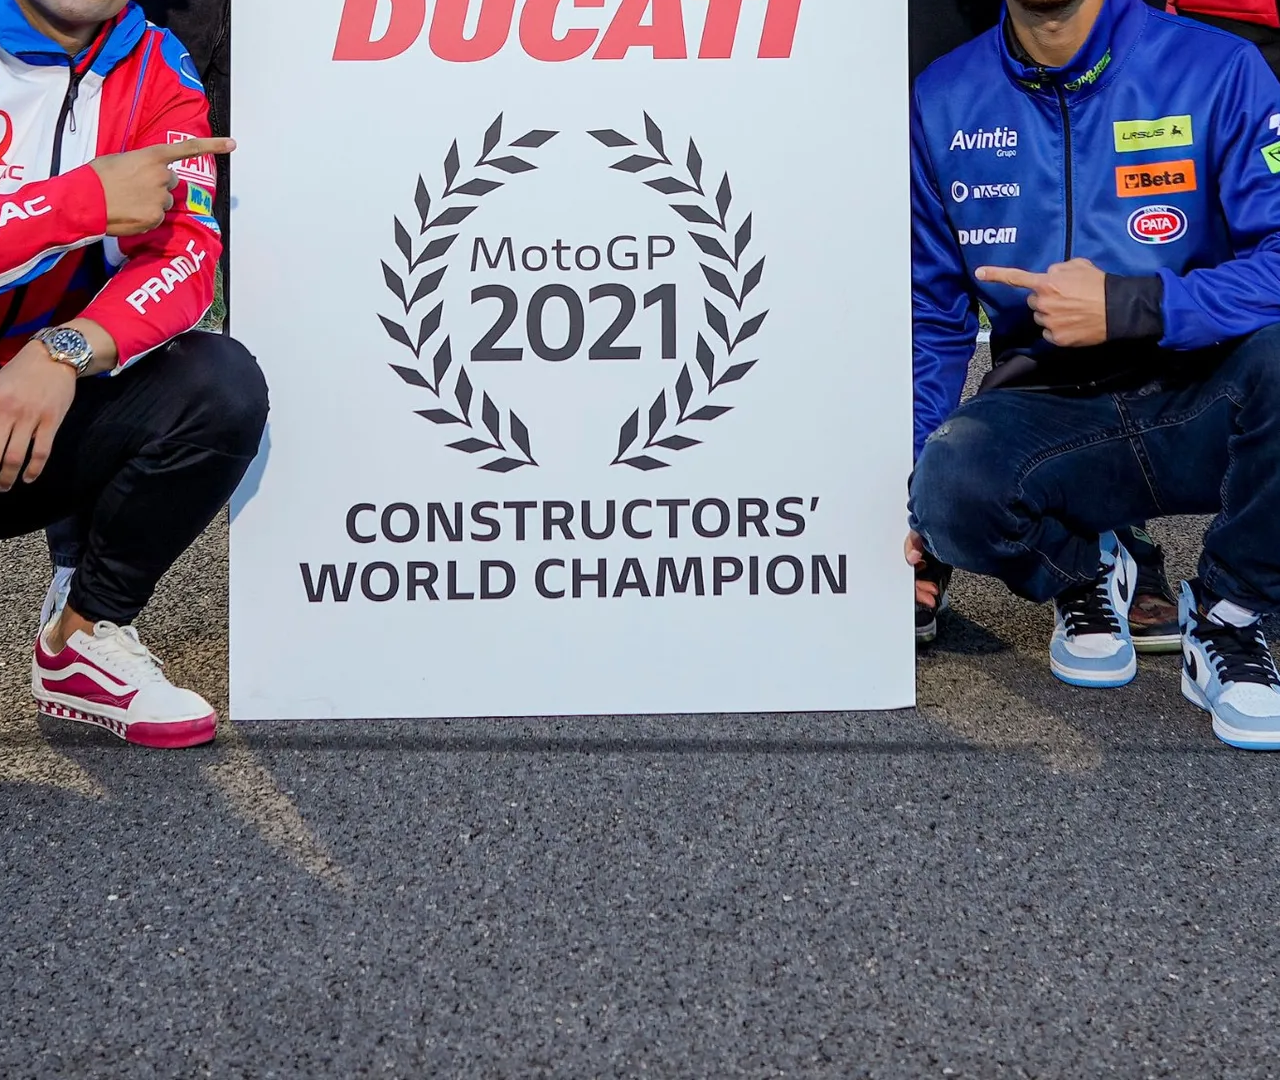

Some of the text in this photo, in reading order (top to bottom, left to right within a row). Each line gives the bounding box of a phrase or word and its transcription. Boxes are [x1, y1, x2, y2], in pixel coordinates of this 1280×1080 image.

[949, 126, 1019, 151] Avintia
[1122, 128, 1165, 140] URSUS
[996, 149, 1017, 159] Grupo
[1140, 171, 1186, 188] Beta
[1140, 217, 1173, 232] PATA
[958, 227, 1017, 245] DUCATI
[469, 234, 676, 272] MotoGP
[469, 283, 678, 362] 2021
[345, 495, 820, 544] CONSTRUCTORS'
[299, 554, 848, 602] WORLD CHAMPION
